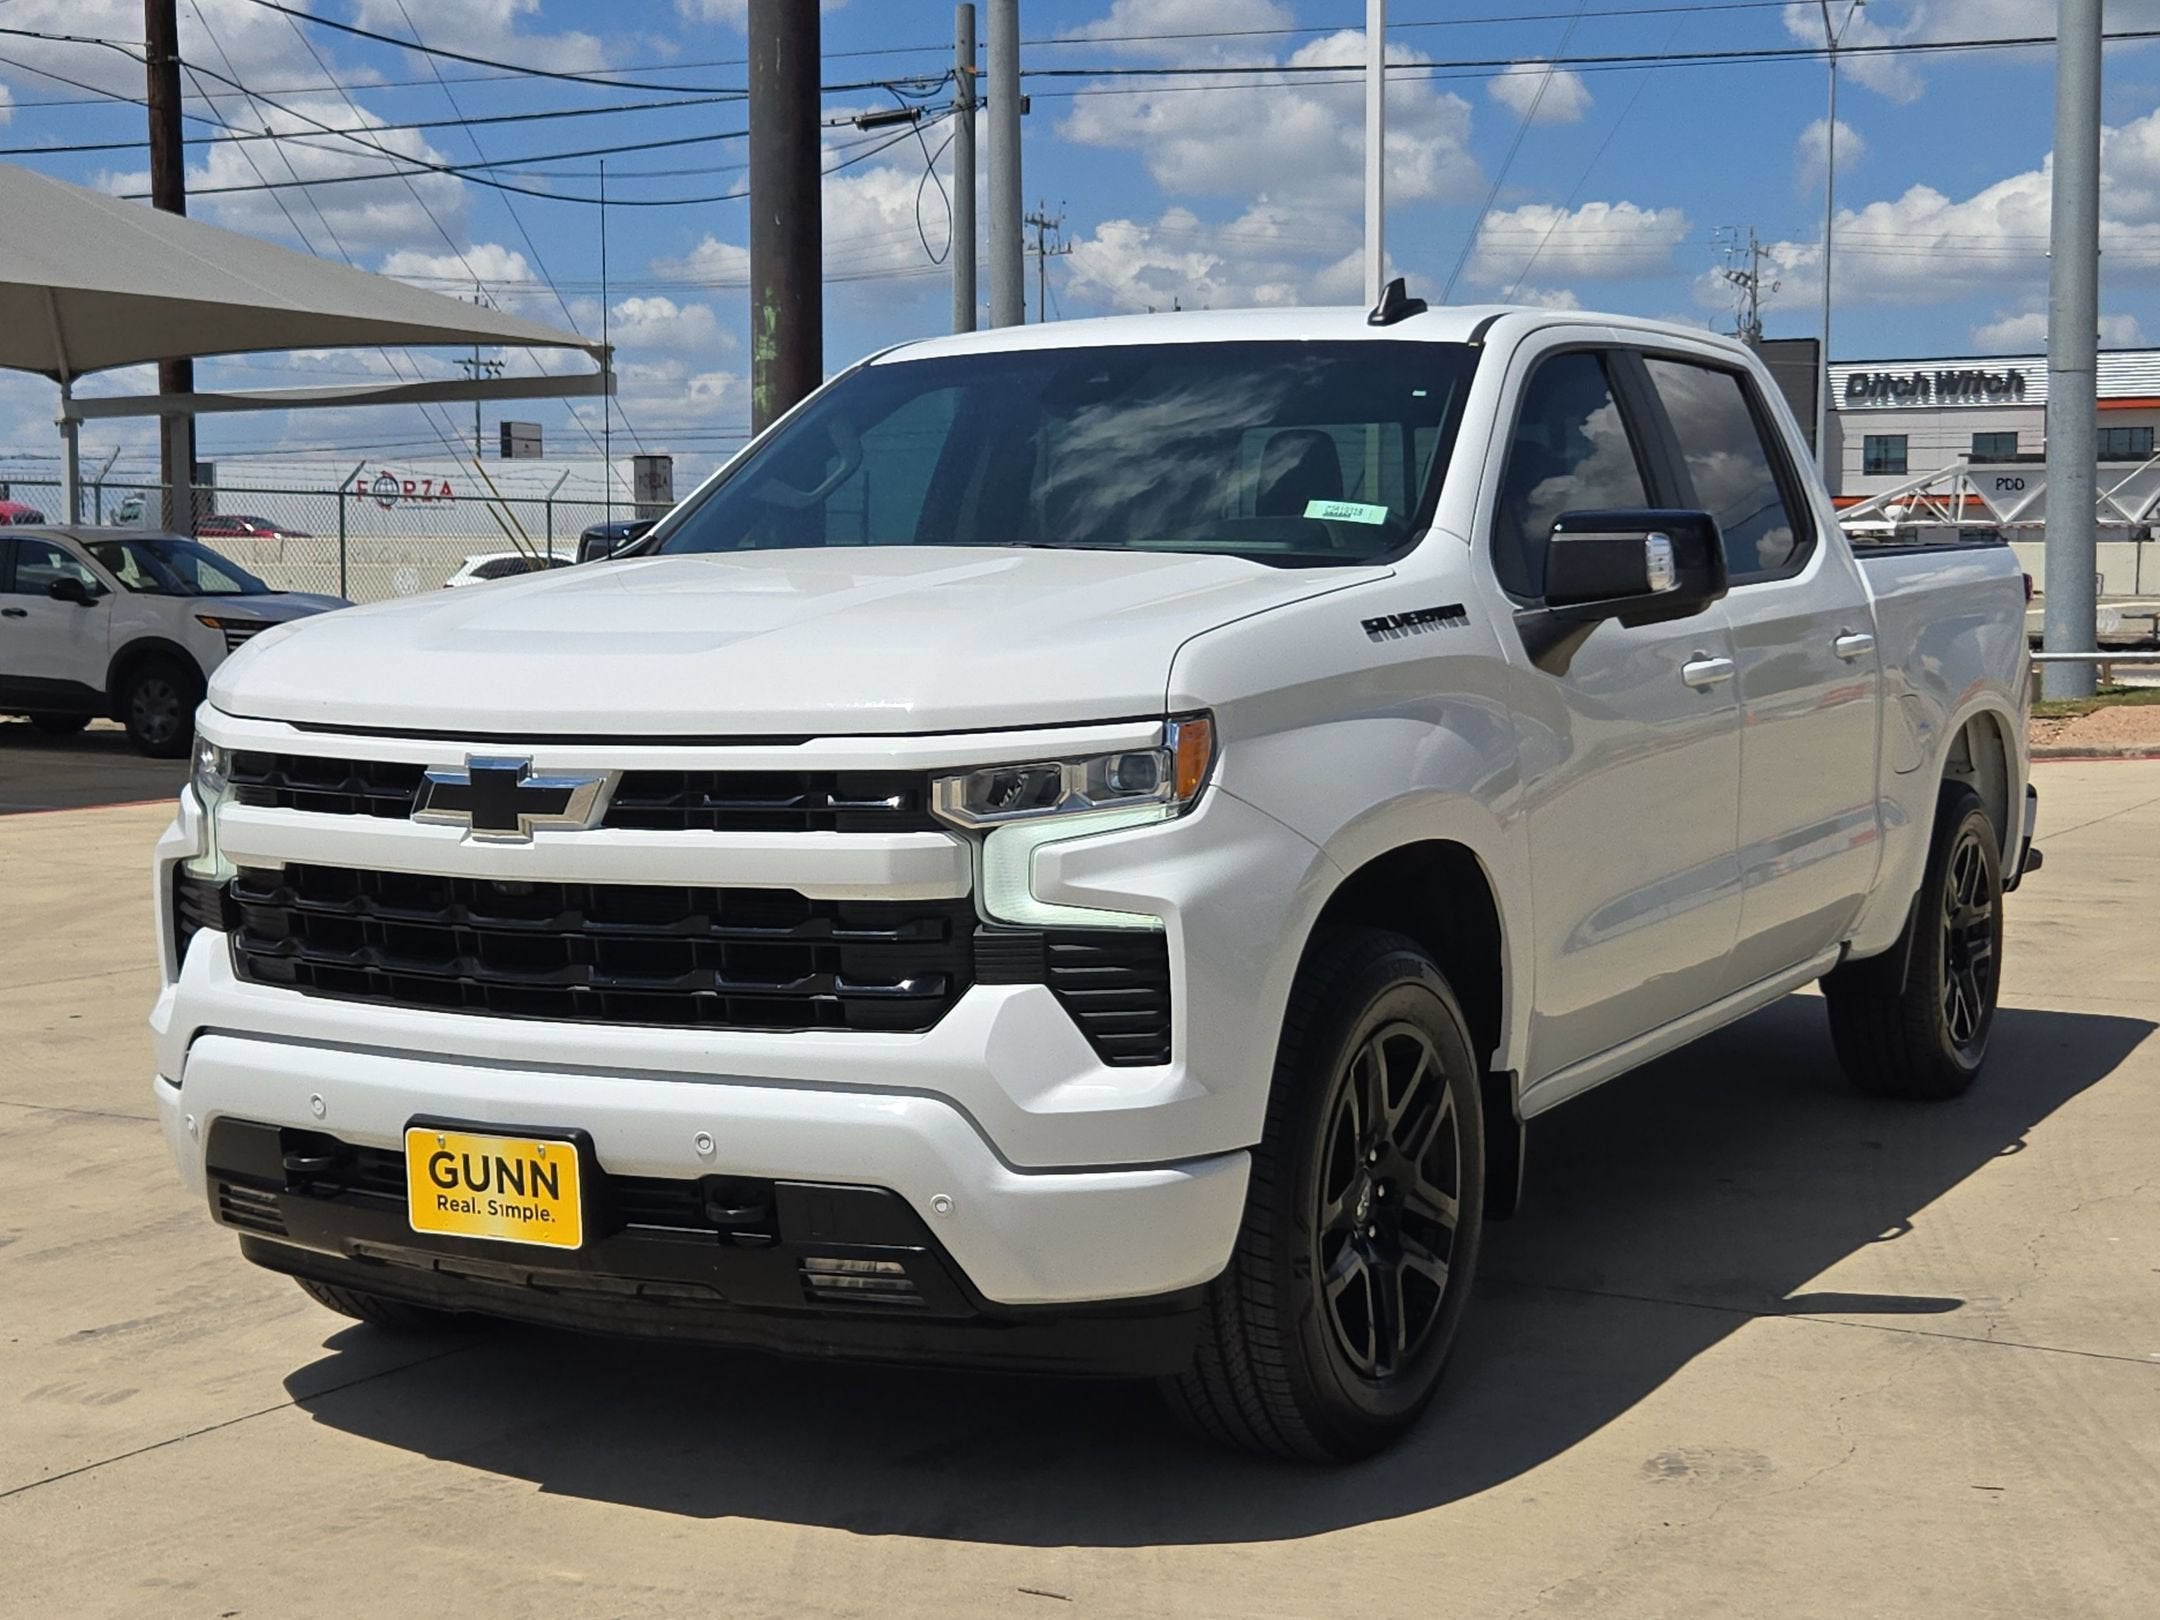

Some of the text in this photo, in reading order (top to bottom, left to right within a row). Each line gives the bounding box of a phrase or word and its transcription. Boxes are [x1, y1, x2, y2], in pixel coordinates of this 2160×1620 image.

[1846, 368, 2026, 400] Ditch Witch
[357, 475, 456, 506] FORZA
[1996, 477, 2025, 491] PDD
[1360, 603, 1467, 635] SILVER
[428, 1151, 560, 1201] GUNN
[437, 1194, 482, 1215] Real.
